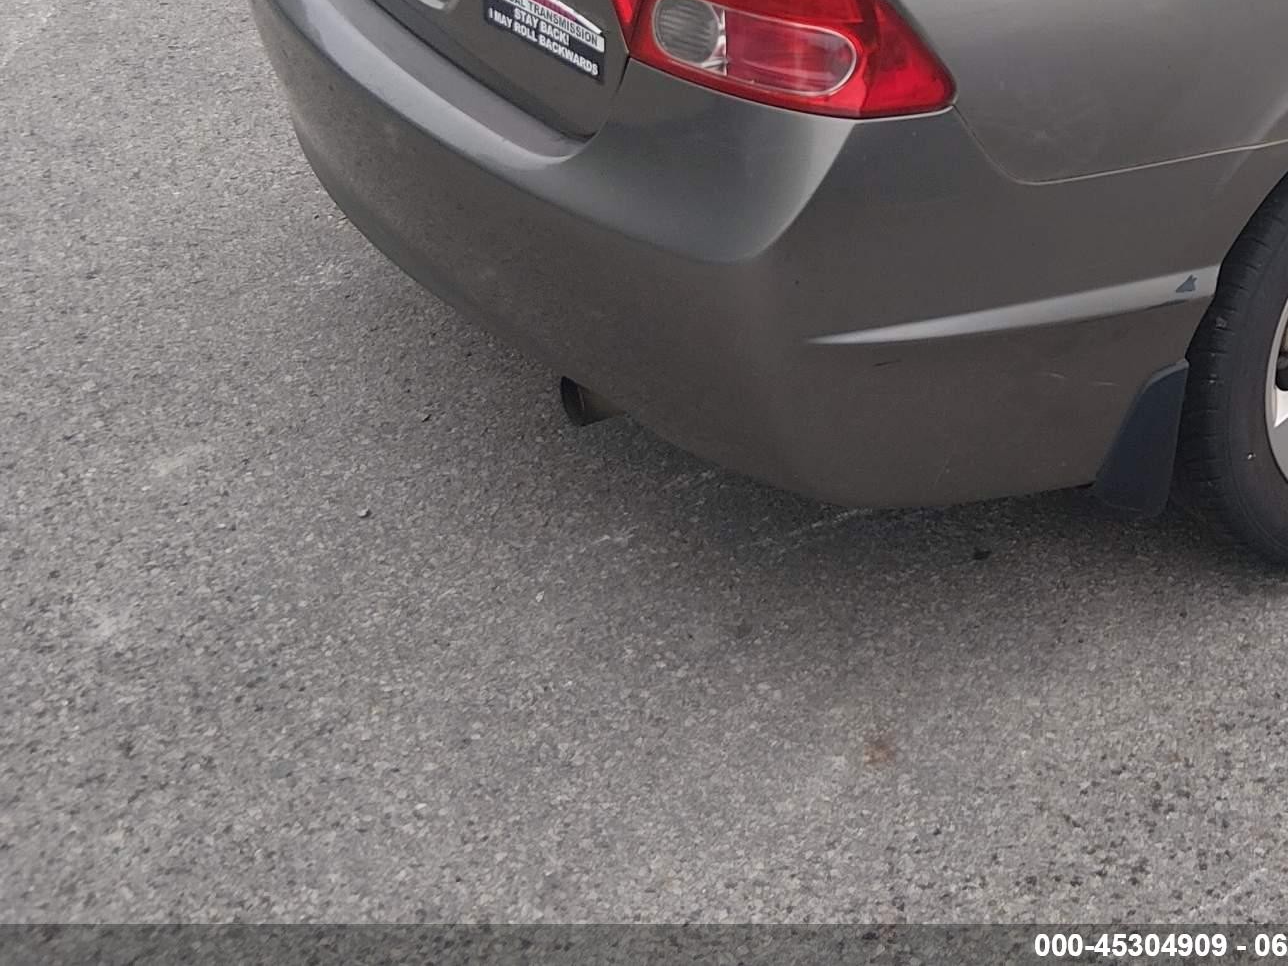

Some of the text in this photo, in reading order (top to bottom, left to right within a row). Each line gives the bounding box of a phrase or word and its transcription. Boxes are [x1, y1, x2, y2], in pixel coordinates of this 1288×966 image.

[488, 7, 599, 76] I MAY ROLL BACKWARDS
[514, 7, 571, 46] STAY BACK!
[528, 0, 598, 47] TRANSMISSION
